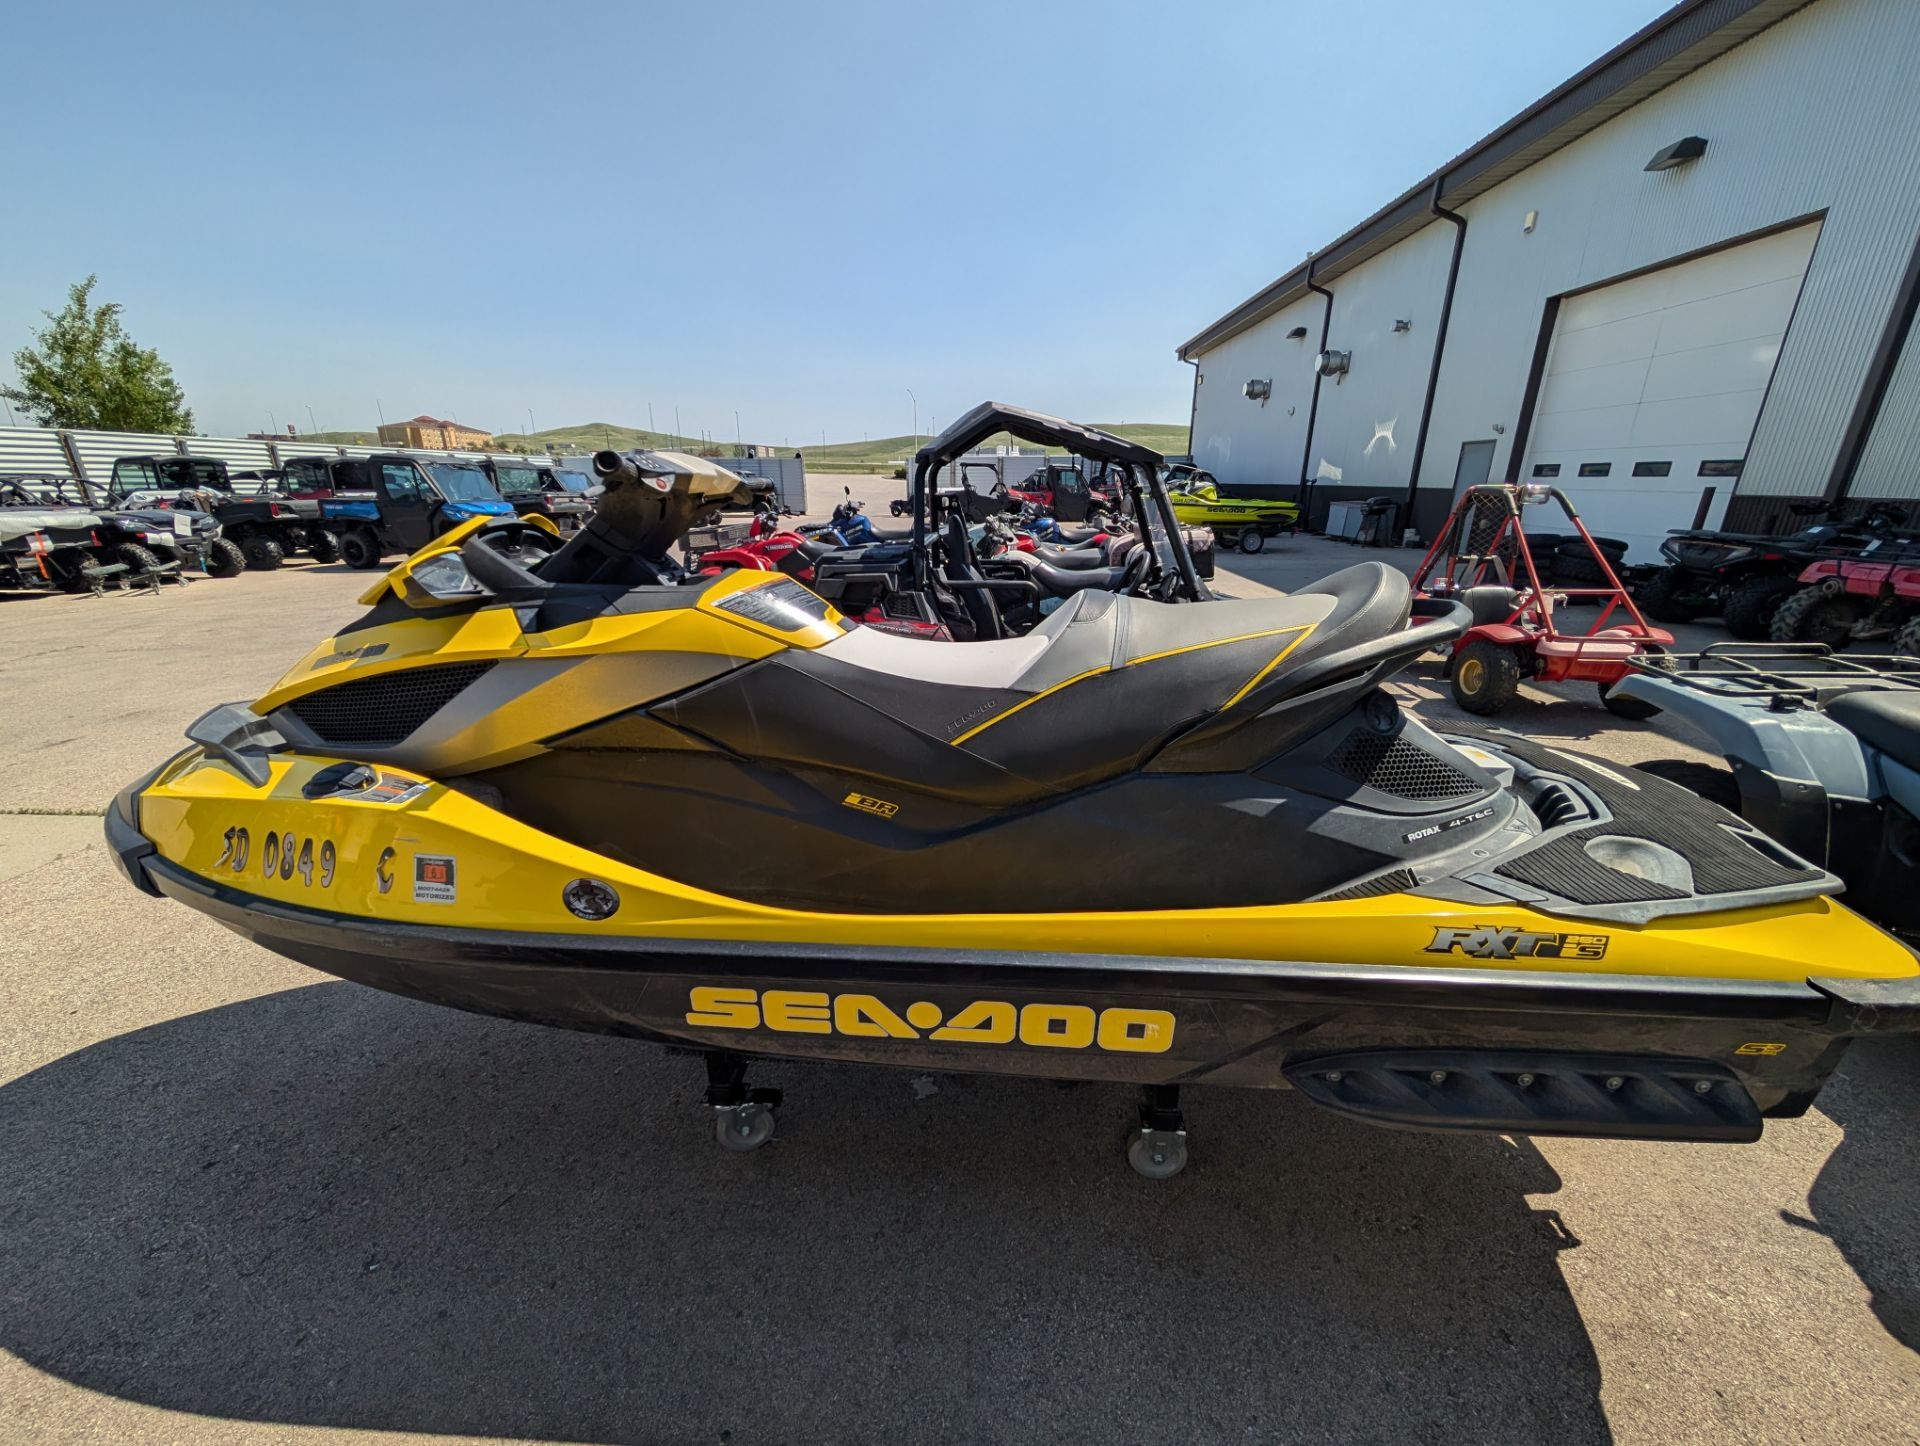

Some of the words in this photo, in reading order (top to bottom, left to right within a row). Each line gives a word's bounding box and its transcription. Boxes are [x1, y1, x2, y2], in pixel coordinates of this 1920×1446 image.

[1408, 825, 1442, 842] ROTAX
[1449, 808, 1494, 827] 4-TEC
[264, 830, 337, 888] 0849
[377, 846, 396, 894] C
[415, 892, 455, 900] MOTORIZED
[1424, 925, 1557, 959] RXT
[1565, 935, 1607, 945] 260
